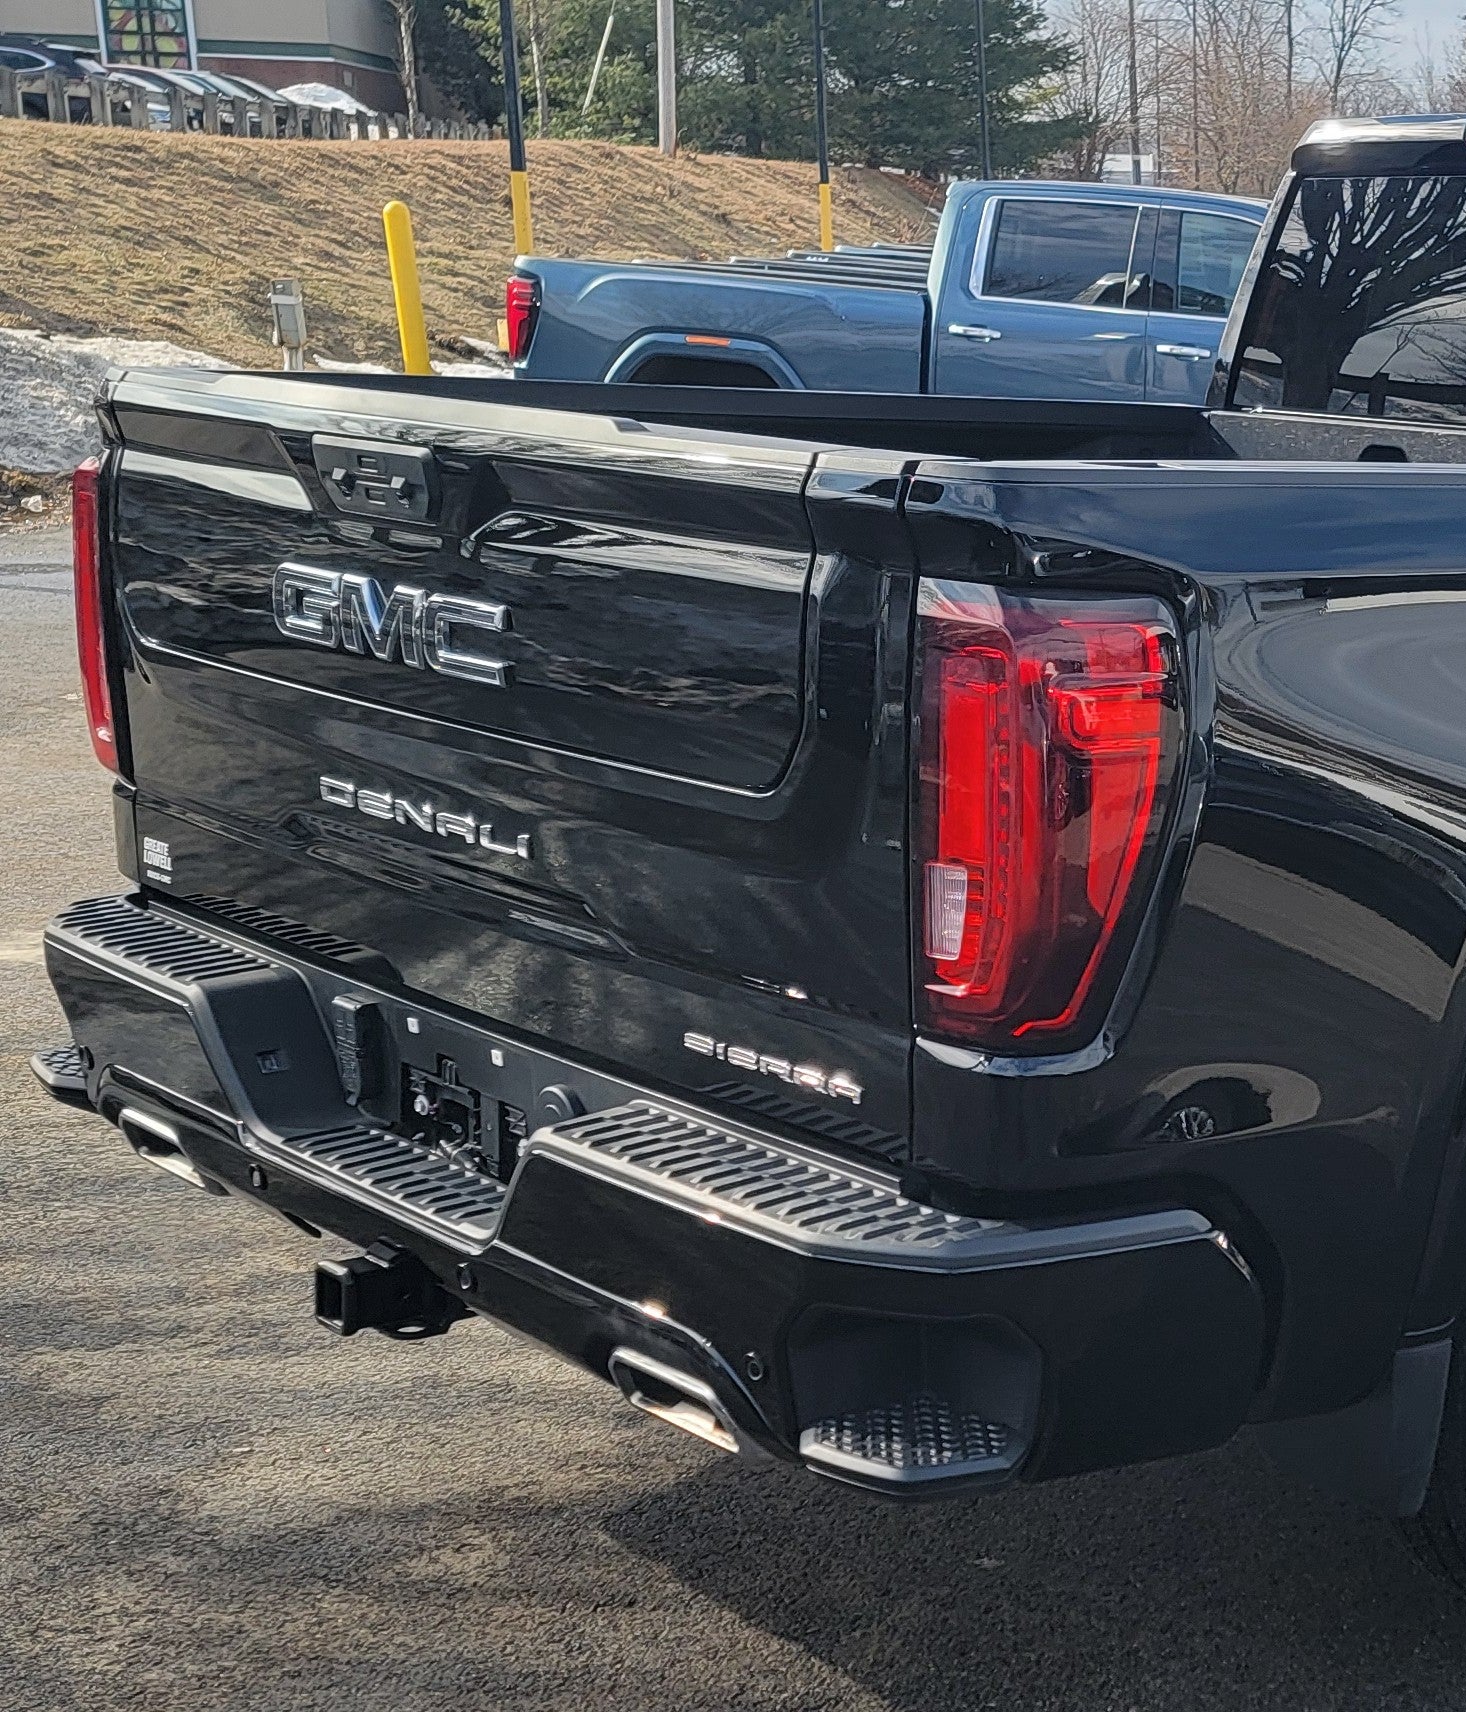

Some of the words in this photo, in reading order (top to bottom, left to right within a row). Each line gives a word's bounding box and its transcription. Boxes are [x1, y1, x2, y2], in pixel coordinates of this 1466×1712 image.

[272, 562, 514, 688] GMC
[319, 776, 531, 860] DENALI
[683, 1031, 867, 1105] SIERRA
